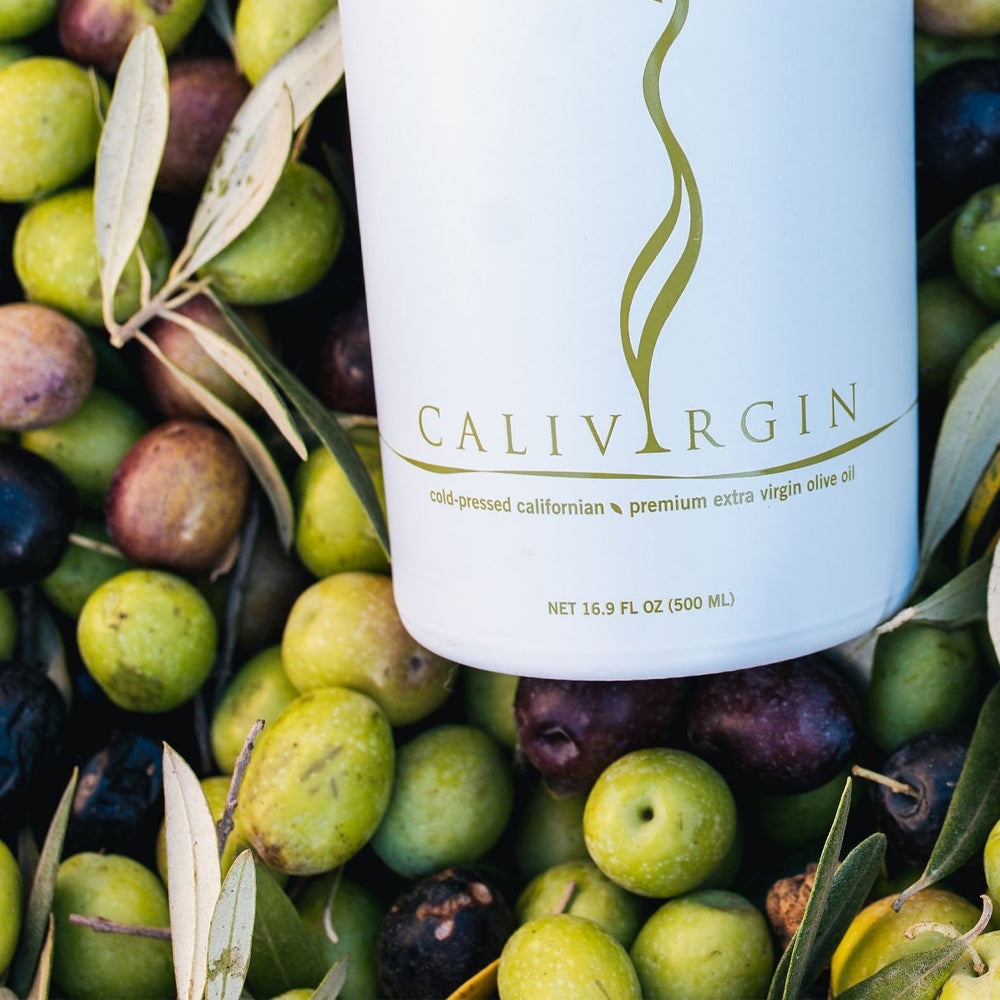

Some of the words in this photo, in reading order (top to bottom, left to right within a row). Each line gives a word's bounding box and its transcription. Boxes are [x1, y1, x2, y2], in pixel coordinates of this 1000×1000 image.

[429, 488, 512, 513] cold-pressed
[516, 498, 605, 516] californian
[629, 495, 707, 518] premium
[713, 489, 755, 508] extra
[760, 481, 802, 501] virgin
[806, 472, 838, 493] olive
[841, 464, 855, 483] oil
[547, 601, 577, 616] NET
[583, 601, 615, 616] 16.9
[620, 601, 639, 616] FL
[642, 600, 664, 614] OZ
[668, 596, 703, 614] (500
[708, 592, 735, 609] ML)
